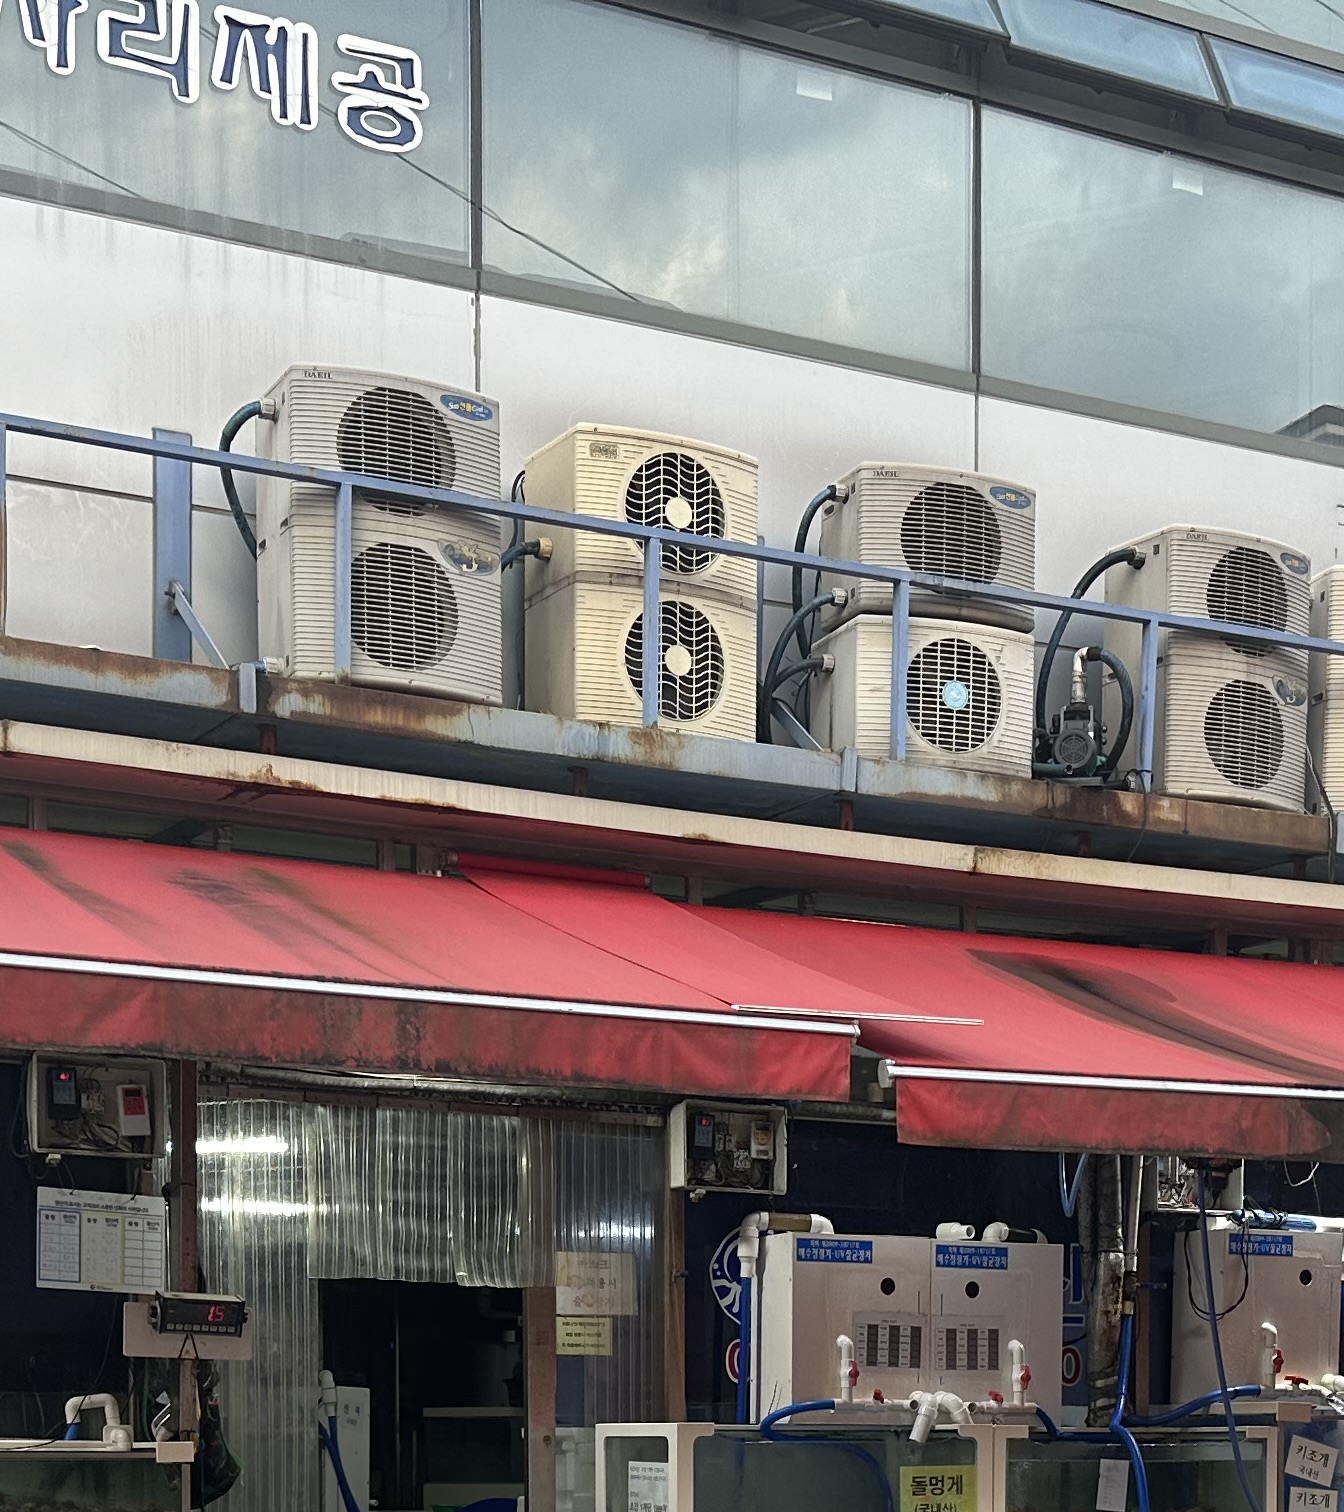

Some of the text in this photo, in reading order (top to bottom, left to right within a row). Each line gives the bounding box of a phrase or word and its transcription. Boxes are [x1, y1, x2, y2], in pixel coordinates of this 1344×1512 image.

[1296, 1445, 1330, 1468] 키조개
[1298, 1464, 1320, 1480] 국내산
[910, 1474, 964, 1497] 돌멍게
[1296, 1492, 1330, 1508] 키조개
